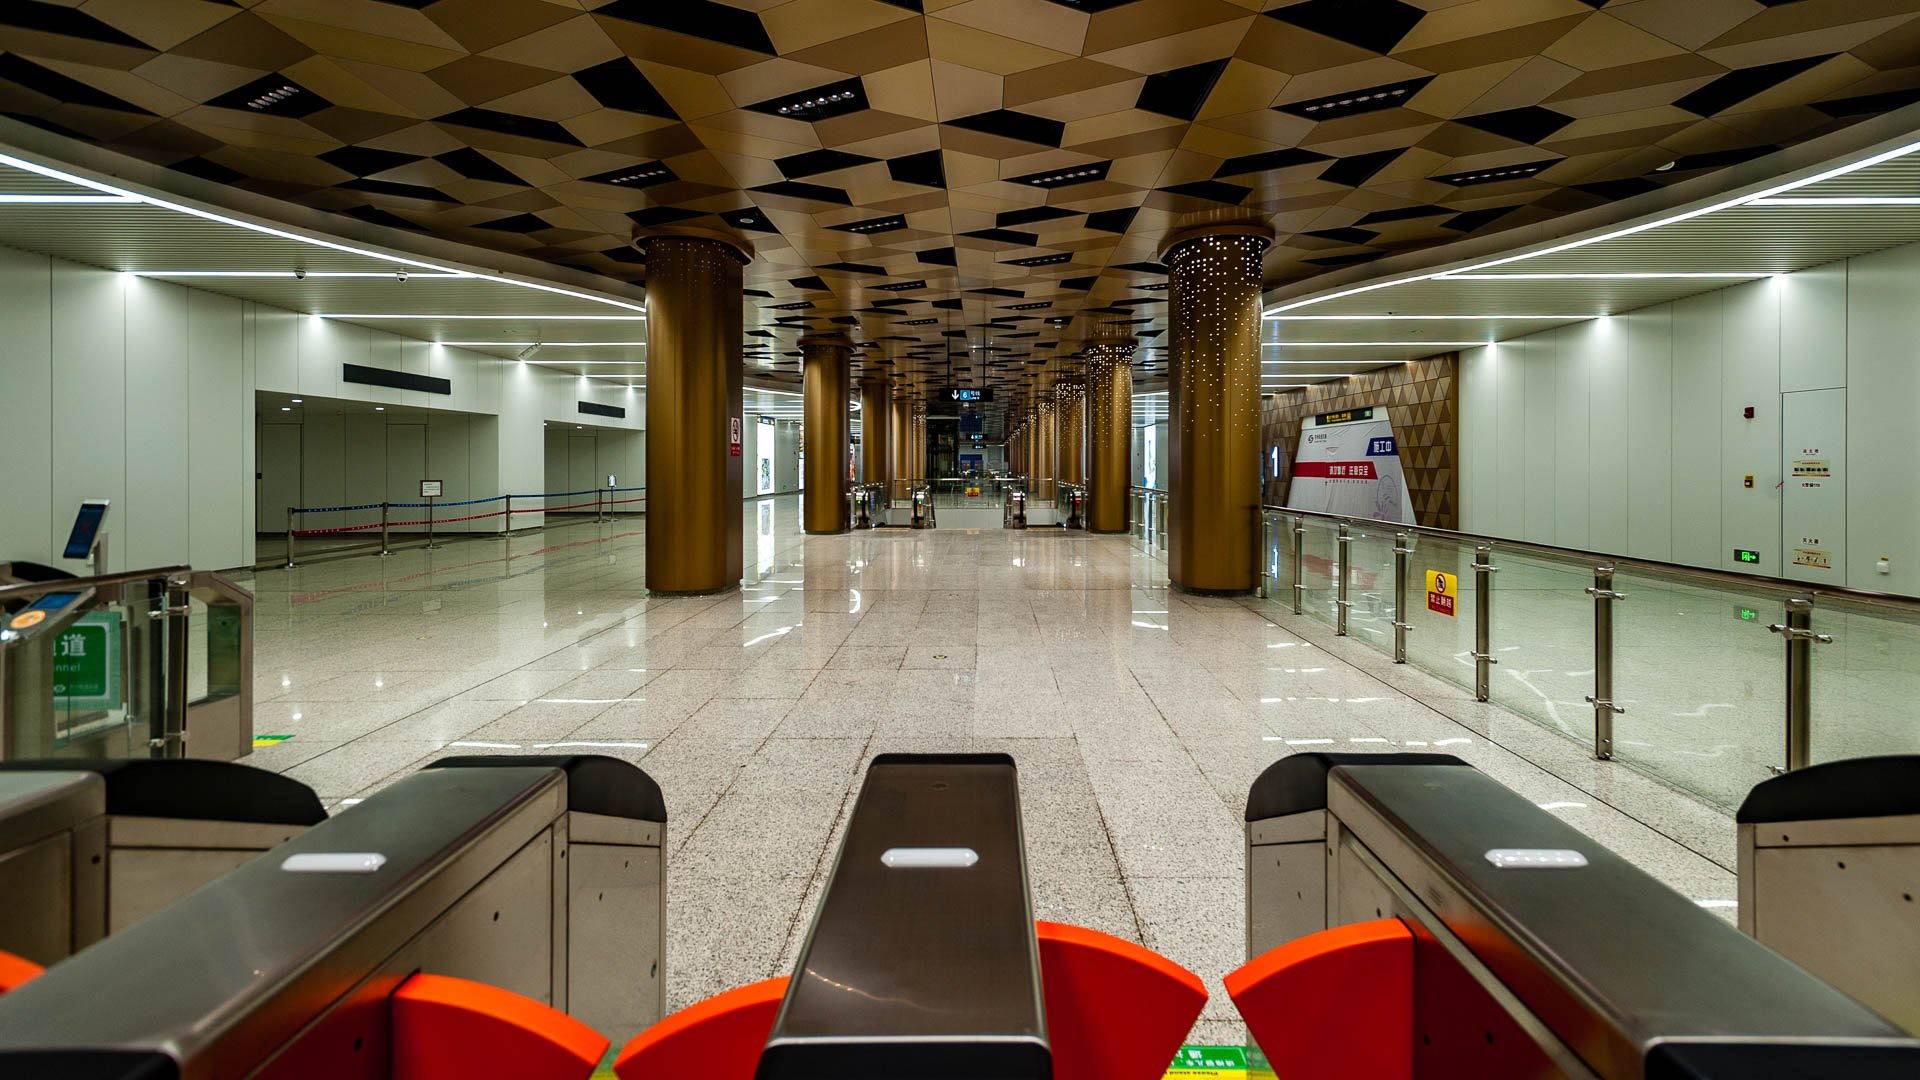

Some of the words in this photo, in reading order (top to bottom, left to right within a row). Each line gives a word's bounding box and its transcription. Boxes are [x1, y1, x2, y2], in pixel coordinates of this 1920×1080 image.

[1373, 440, 1392, 453] 施工中
[1271, 445, 1279, 478] 1
[1348, 465, 1369, 476] 注意安全
